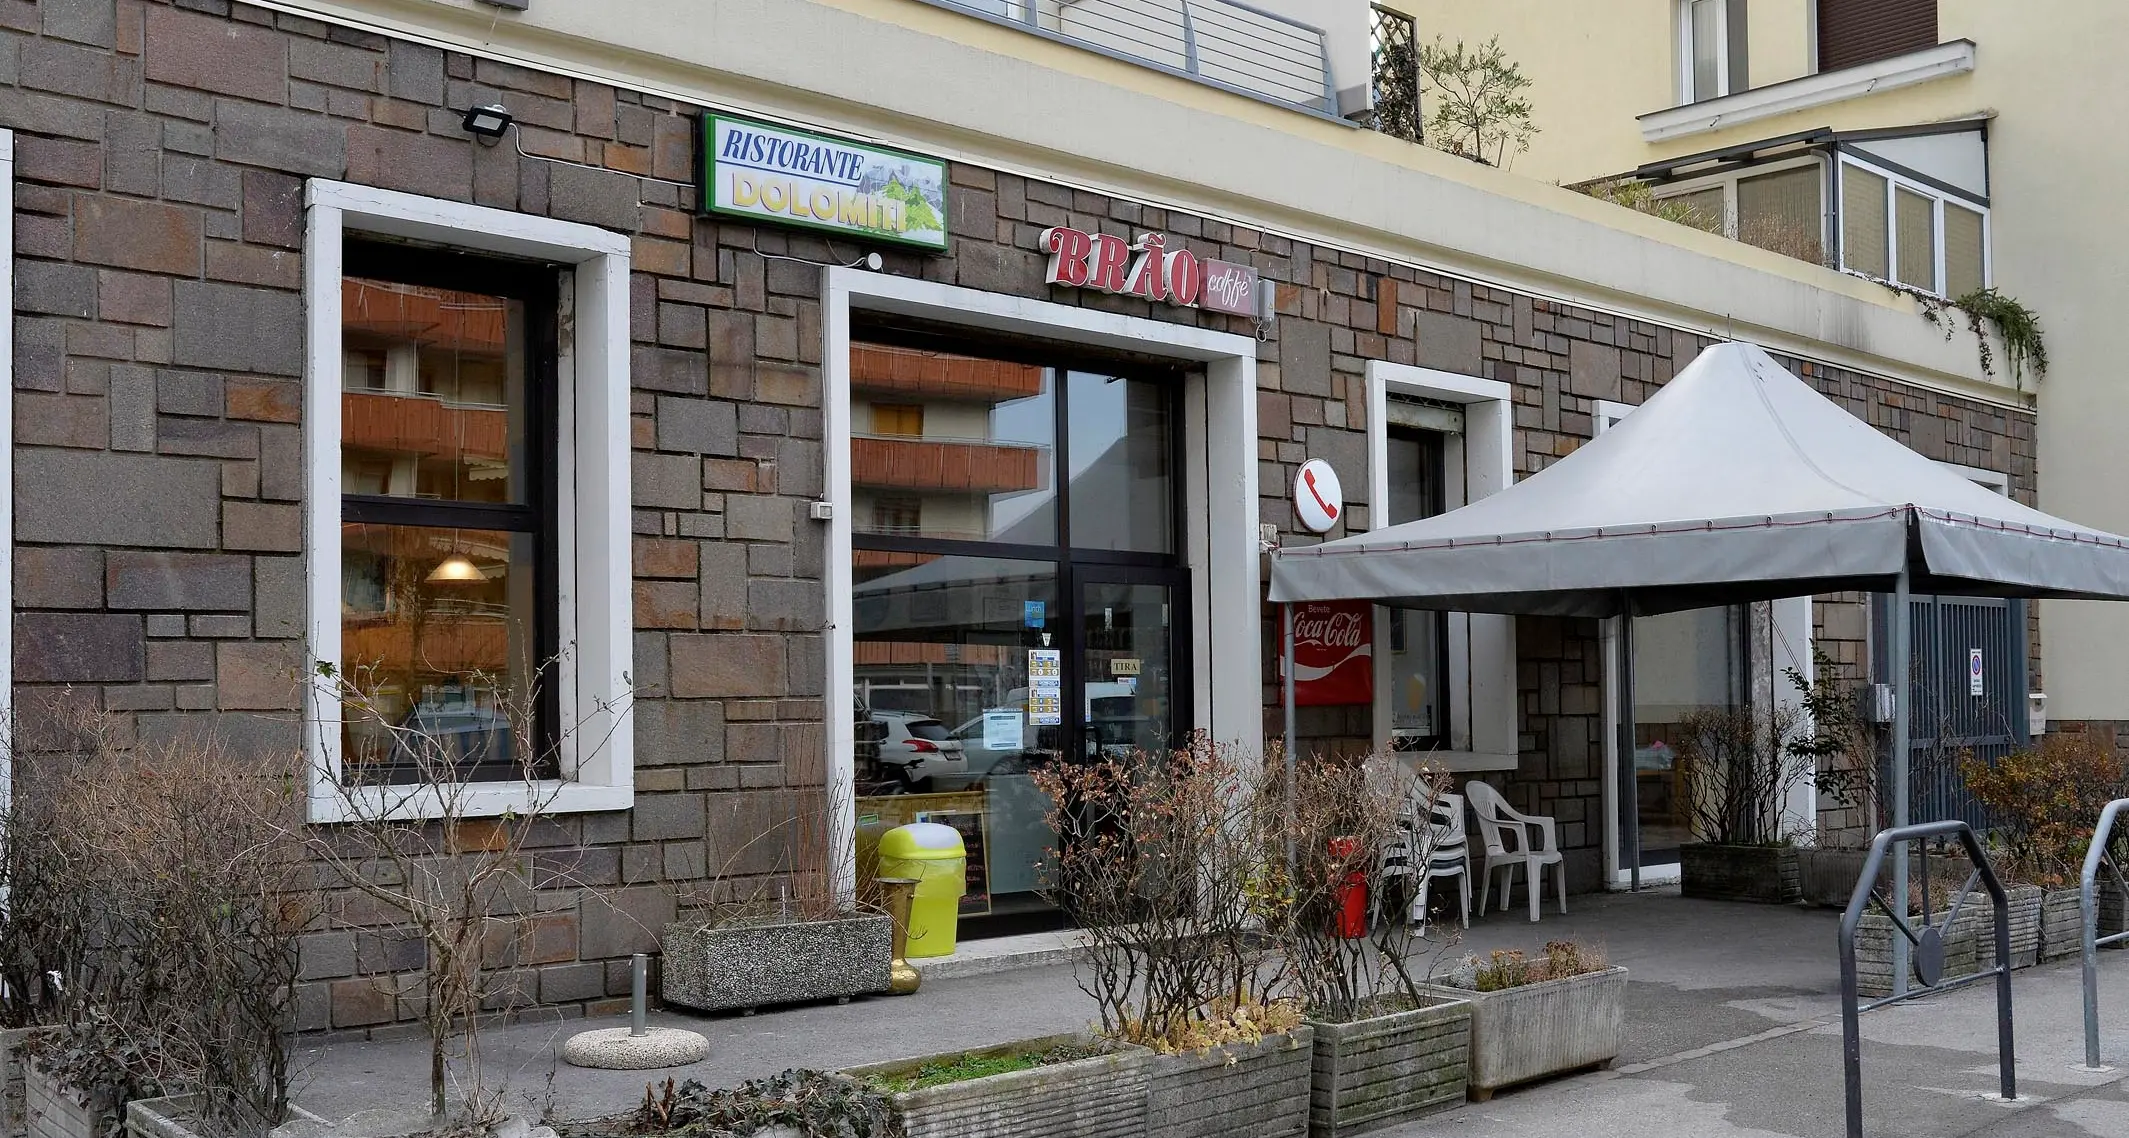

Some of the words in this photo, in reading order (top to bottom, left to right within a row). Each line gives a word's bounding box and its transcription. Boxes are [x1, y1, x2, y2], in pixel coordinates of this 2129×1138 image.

[723, 129, 864, 181] RISTORANTE
[732, 172, 906, 233] DOLOMITI
[1046, 226, 1199, 306] BRÃO
[1308, 604, 1331, 613] Bevete
[1114, 662, 1137, 671] TIRA
